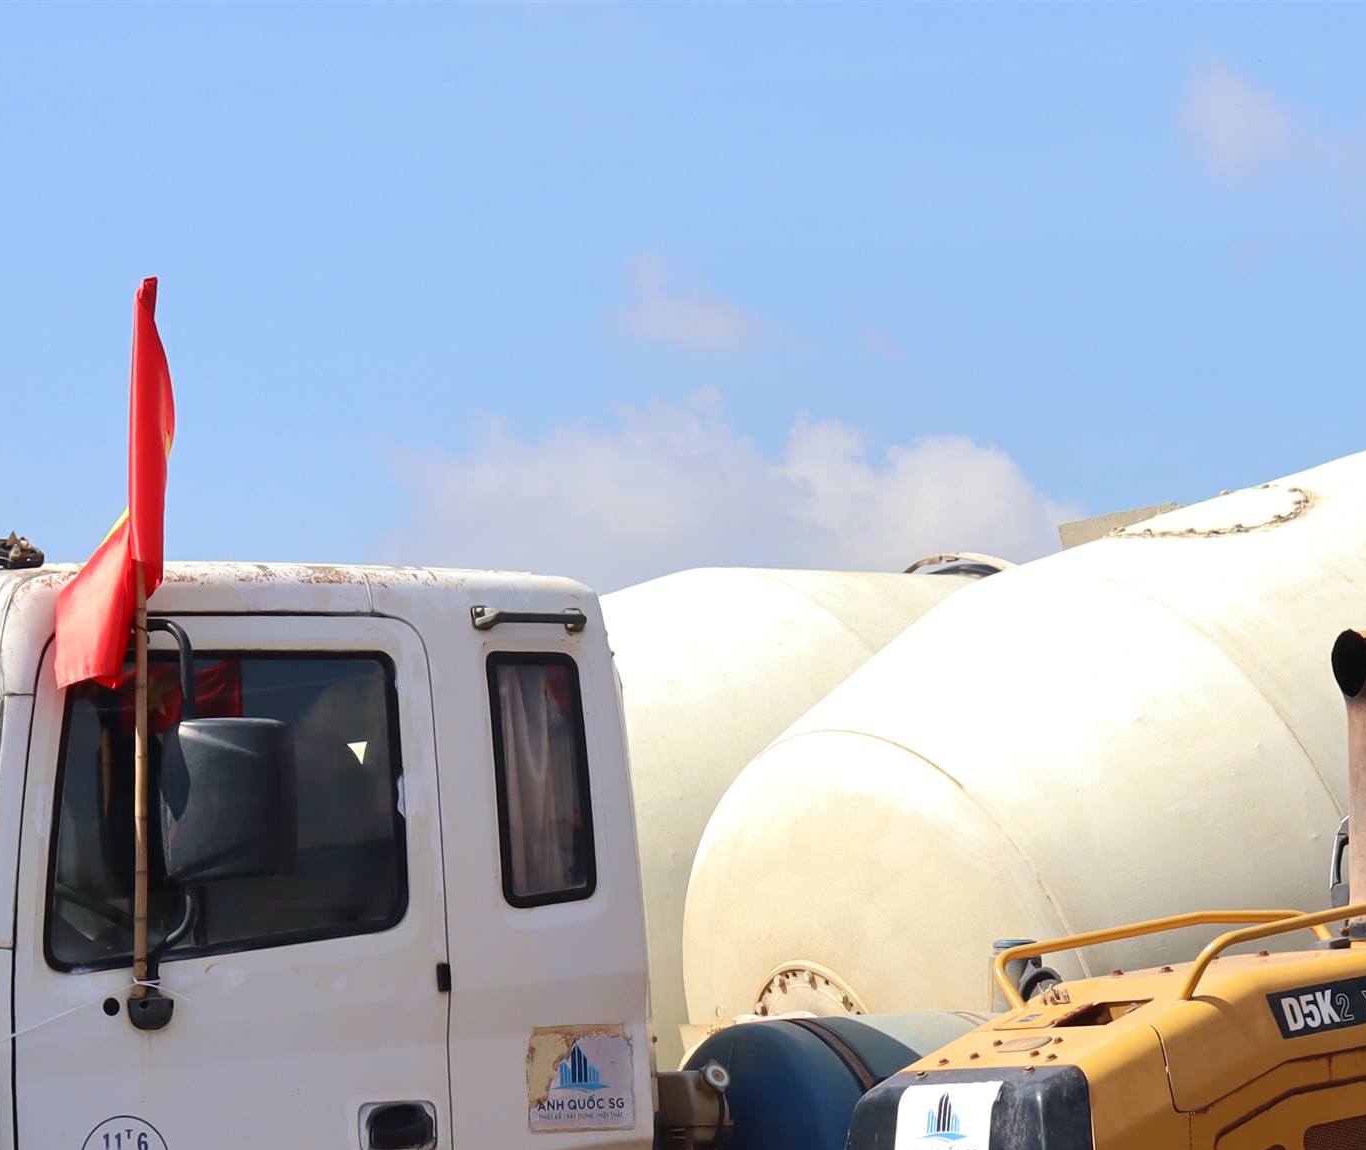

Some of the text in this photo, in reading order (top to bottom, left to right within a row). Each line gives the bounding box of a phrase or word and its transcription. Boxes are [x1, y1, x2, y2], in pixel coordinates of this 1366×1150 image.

[1281, 989, 1354, 1032] D5K2
[538, 1094, 625, 1111] ANH QUỐC SG
